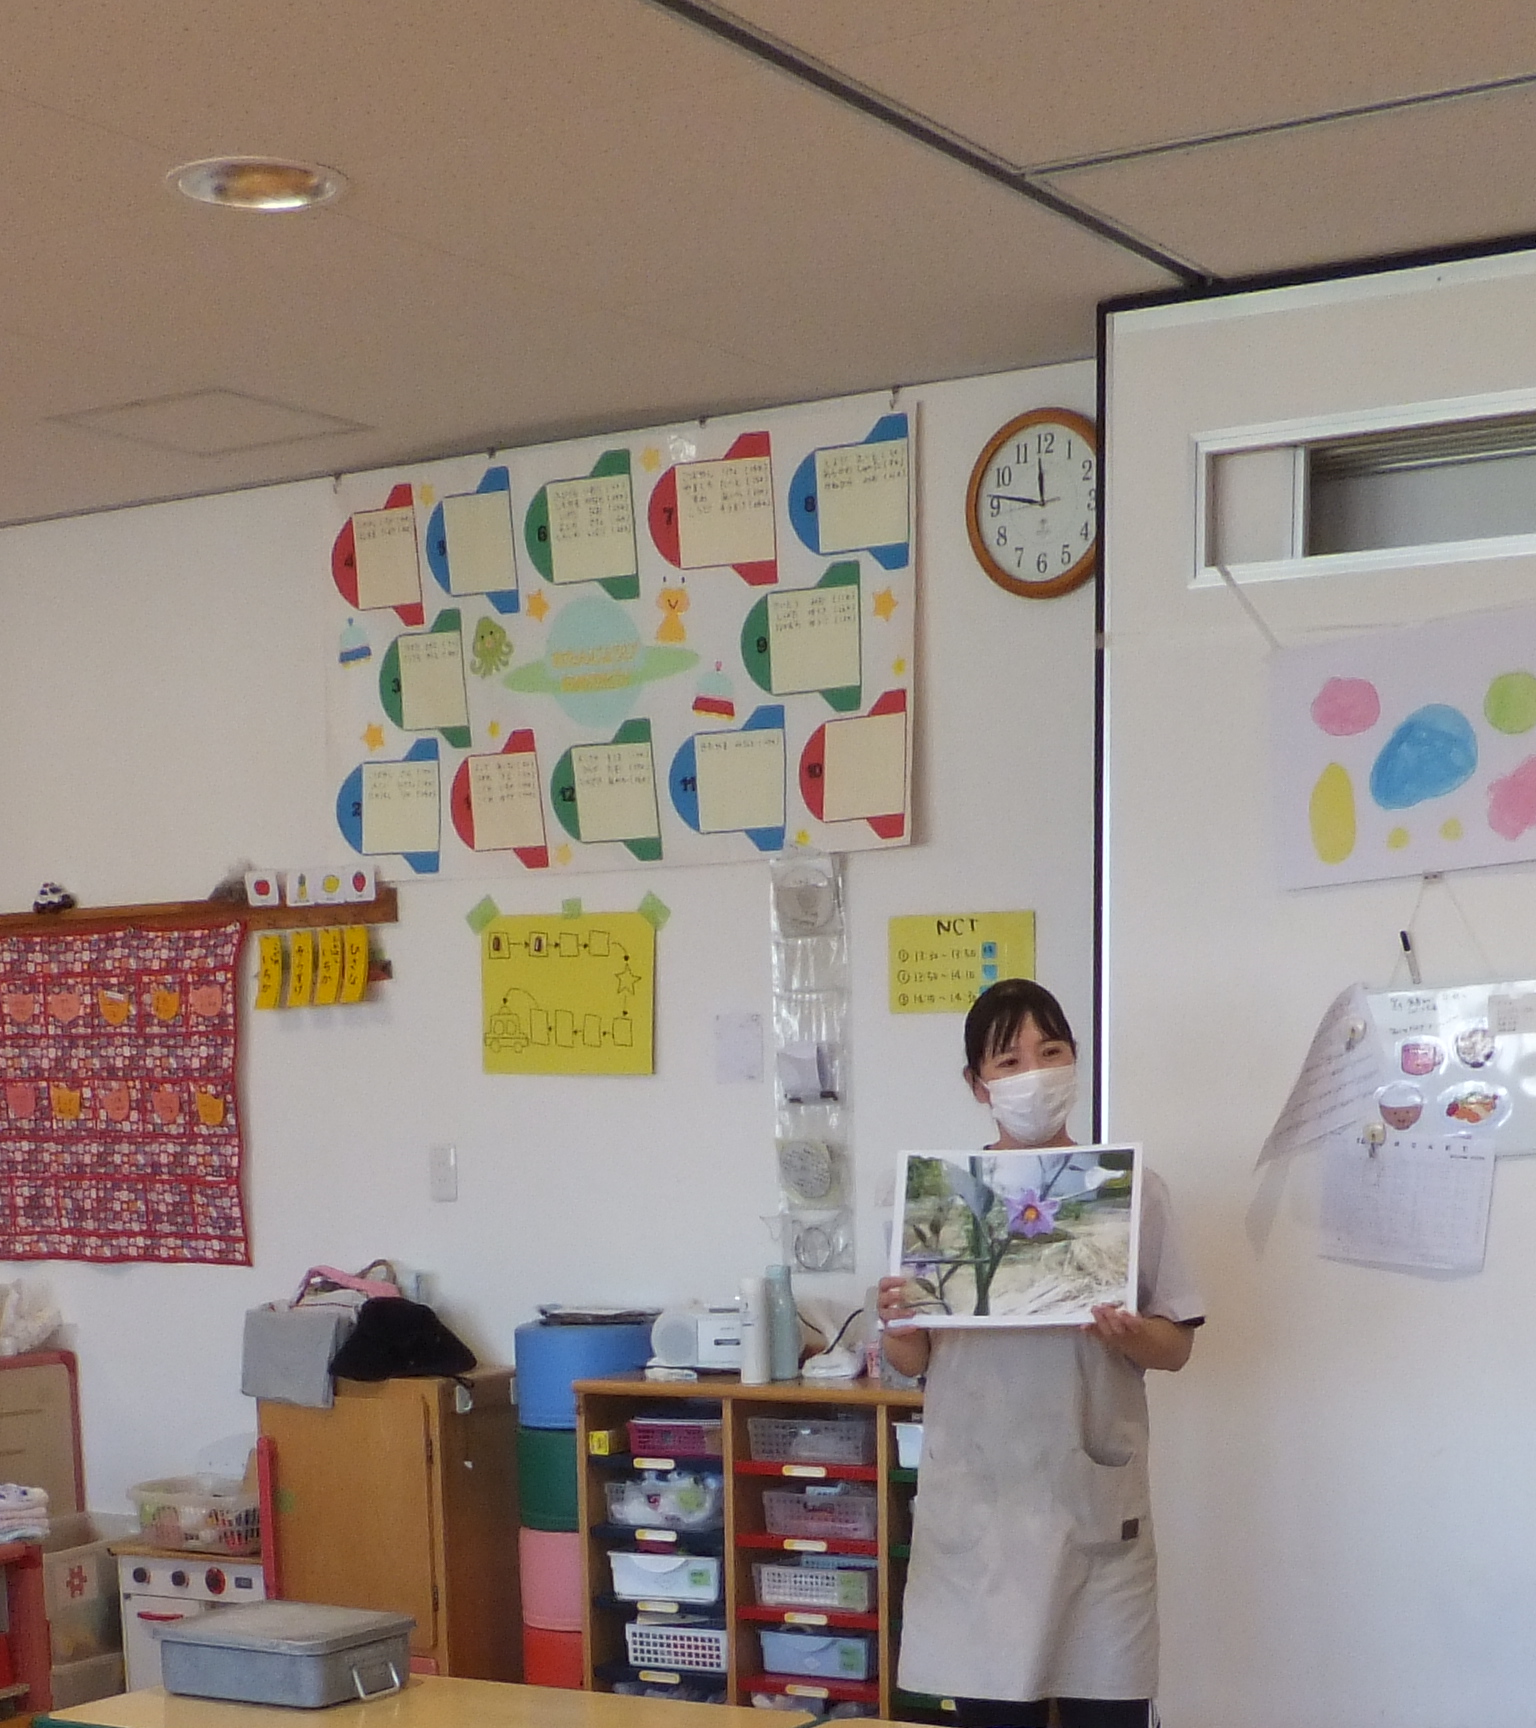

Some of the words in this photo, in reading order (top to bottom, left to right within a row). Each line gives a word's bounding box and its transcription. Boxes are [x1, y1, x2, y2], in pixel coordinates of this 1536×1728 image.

[1015, 443, 1028, 464] 11
[1036, 432, 1054, 454] 12
[1067, 439, 1072, 460] 1
[996, 466, 1012, 487] 10
[1082, 459, 1092, 481] 2
[990, 496, 1001, 518] 9
[1087, 488, 1096, 511] 3
[996, 526, 1007, 546] 8
[1080, 521, 1089, 541] 4
[1015, 547, 1024, 568] 7
[1037, 553, 1047, 574] 6
[1061, 544, 1071, 565] 5
[936, 918, 978, 936] NCT
